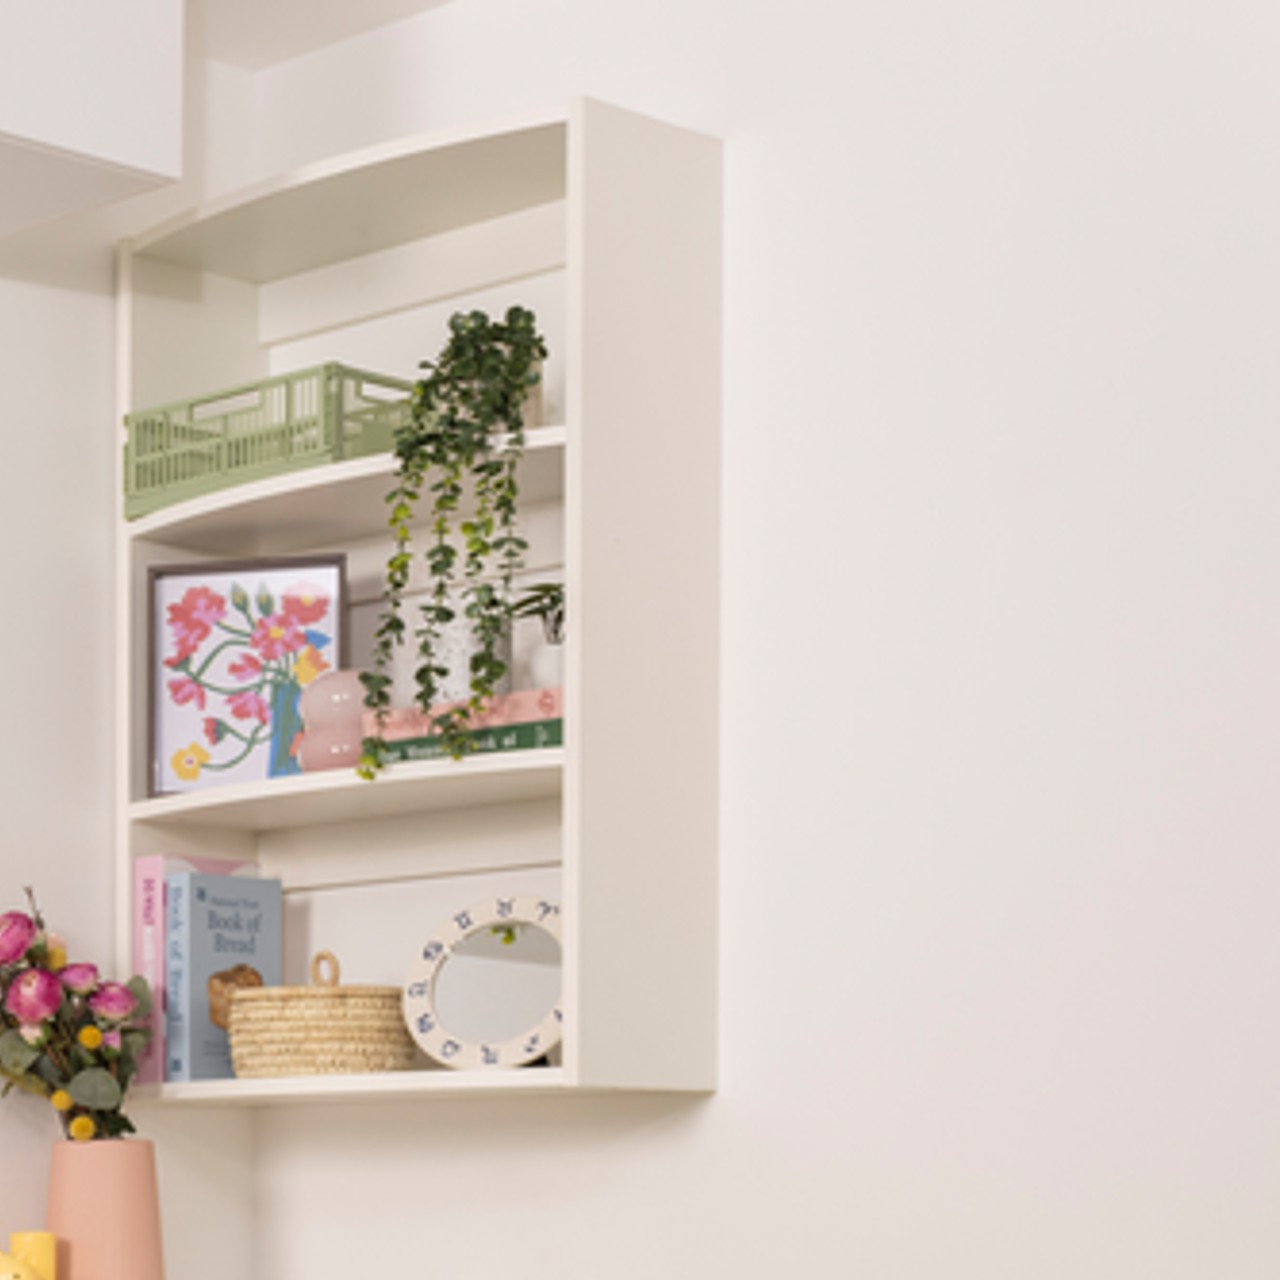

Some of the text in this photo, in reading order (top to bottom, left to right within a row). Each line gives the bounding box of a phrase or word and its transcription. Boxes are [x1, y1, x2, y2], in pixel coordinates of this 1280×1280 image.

[208, 910, 263, 933] Book of
[214, 933, 255, 955] Bread
